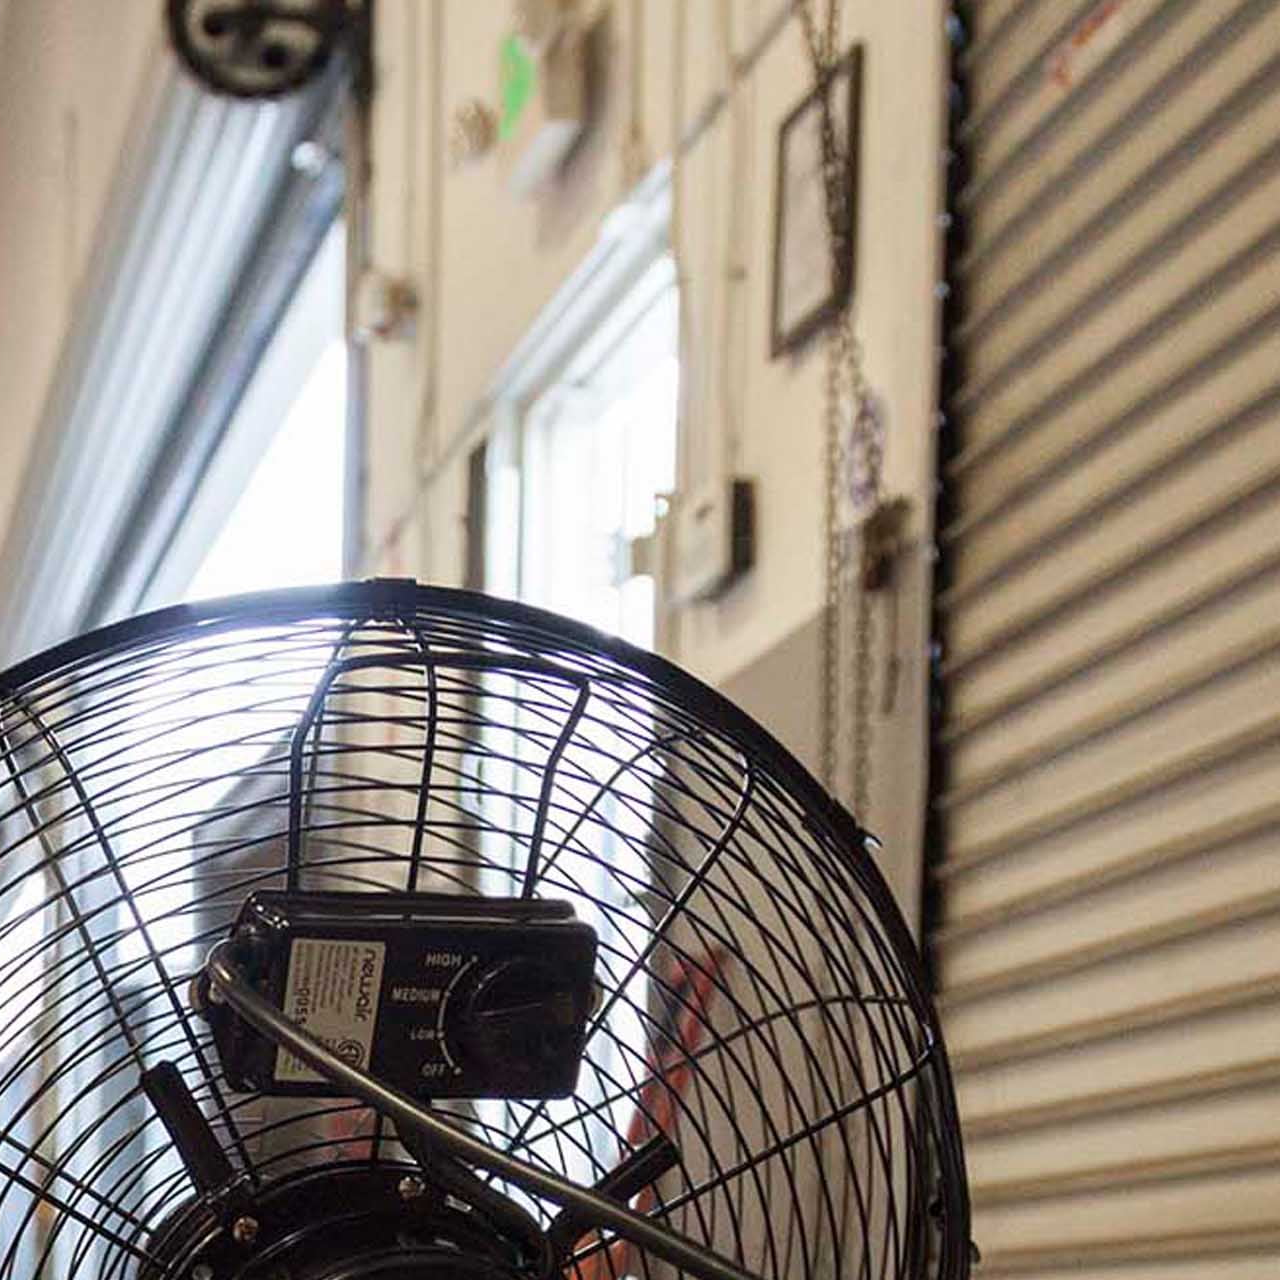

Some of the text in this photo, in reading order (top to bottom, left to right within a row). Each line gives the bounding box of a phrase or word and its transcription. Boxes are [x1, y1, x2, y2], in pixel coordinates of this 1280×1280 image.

[425, 952, 462, 968] HIGH
[392, 987, 441, 1001] MEDIUM
[410, 1027, 435, 1040] LOW
[421, 1063, 446, 1077] OFF
